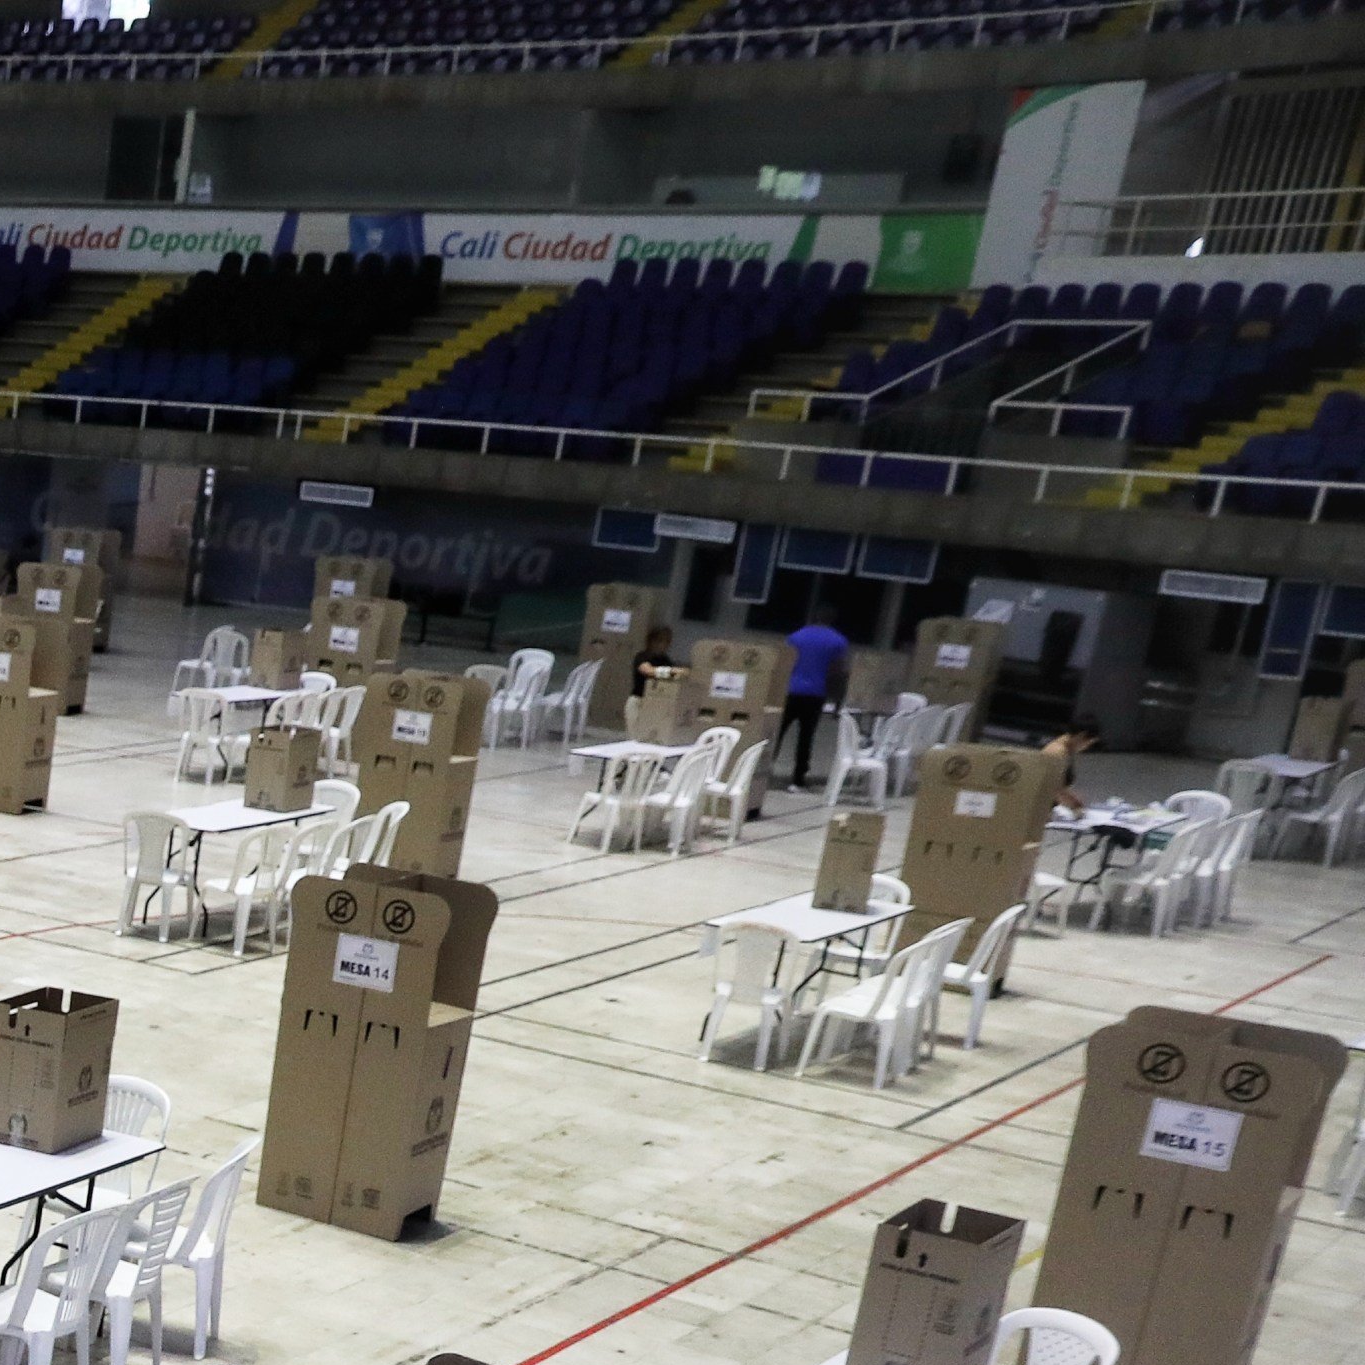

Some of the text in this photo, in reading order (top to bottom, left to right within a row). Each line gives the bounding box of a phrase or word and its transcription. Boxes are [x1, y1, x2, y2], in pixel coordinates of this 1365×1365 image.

[26, 223, 126, 250] Ciudad
[127, 224, 262, 256] Deportiva
[440, 230, 773, 262] Cali Ciudad Deportiva
[340, 960, 389, 981] MESA 14
[1153, 1131, 1228, 1158] MESA 15
